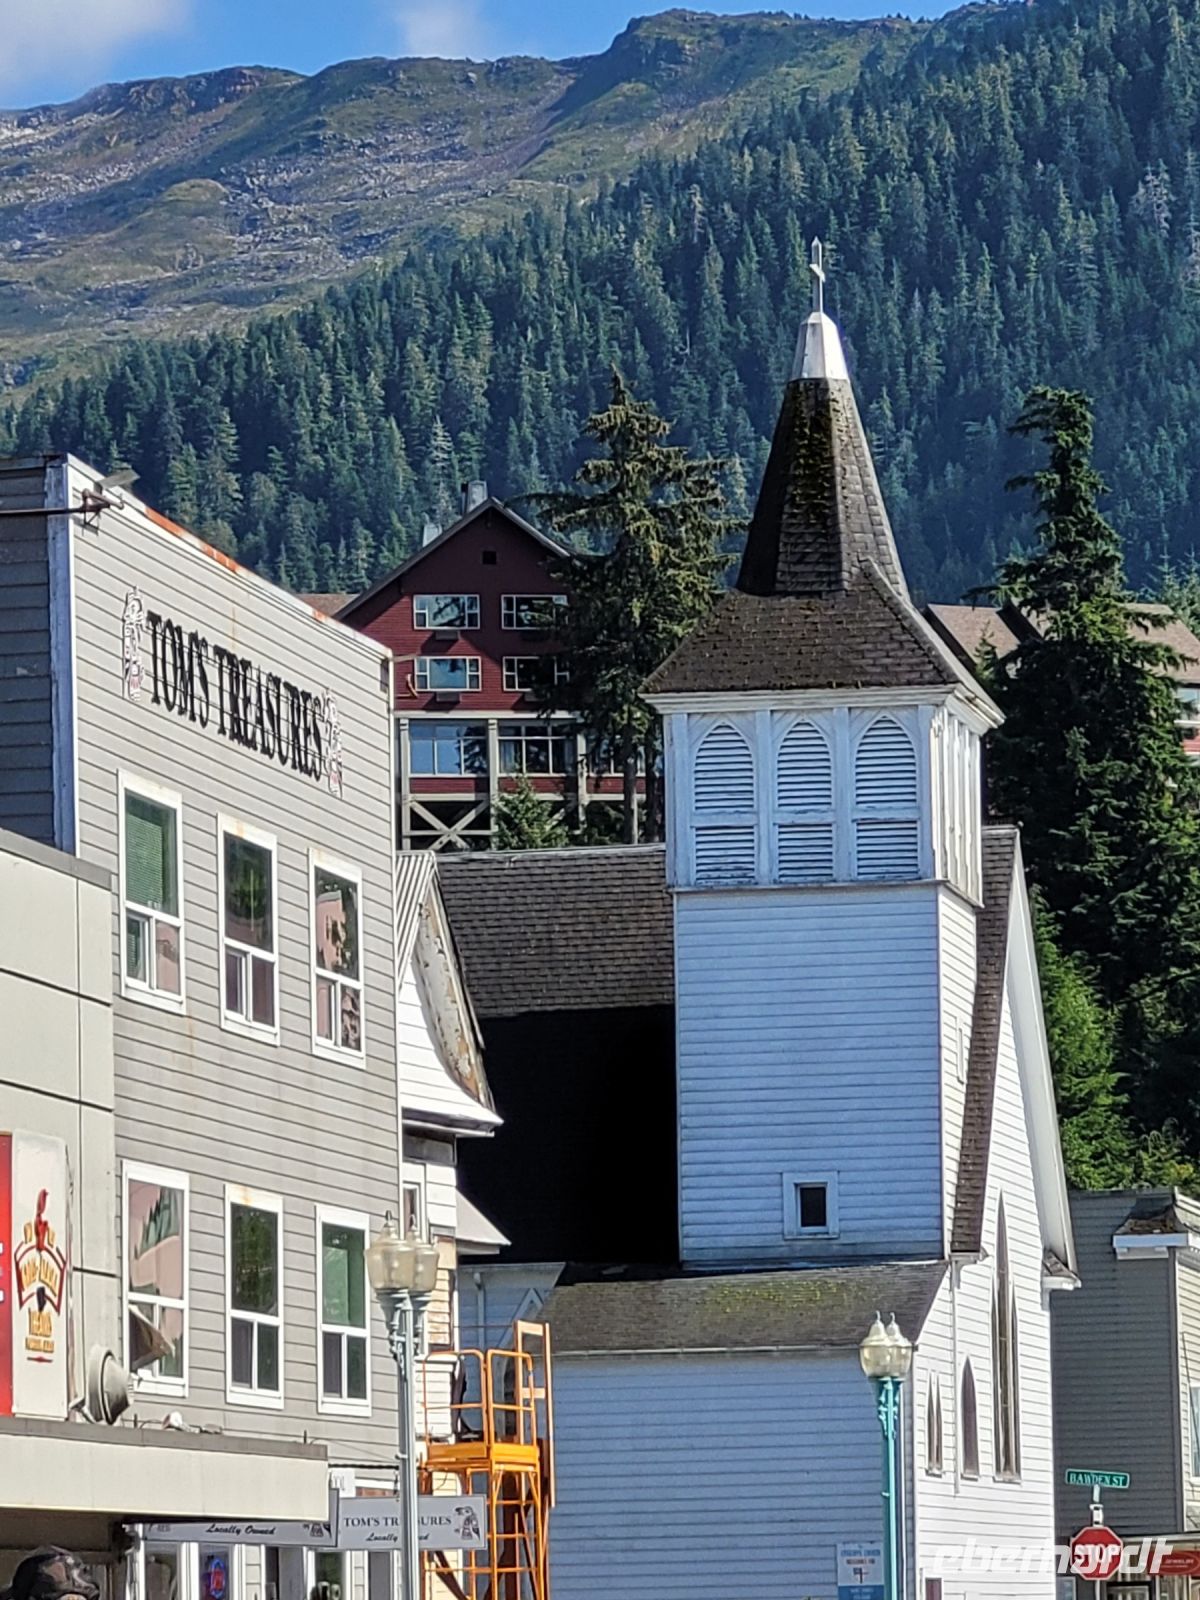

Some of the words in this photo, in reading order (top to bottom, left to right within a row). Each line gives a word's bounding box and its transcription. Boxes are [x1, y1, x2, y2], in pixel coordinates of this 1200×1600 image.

[147, 610, 210, 729] TOM'S
[213, 644, 323, 782] TREASURES
[1069, 1472, 1111, 1486] BAWDEN
[1111, 1475, 1126, 1487] ST
[343, 1517, 380, 1527] TOM'S
[382, 1515, 452, 1527] TRURES
[205, 1523, 242, 1535] Locally
[244, 1525, 276, 1535] Owned
[365, 1532, 399, 1543] Locally
[1074, 1544, 1121, 1563] STOP
